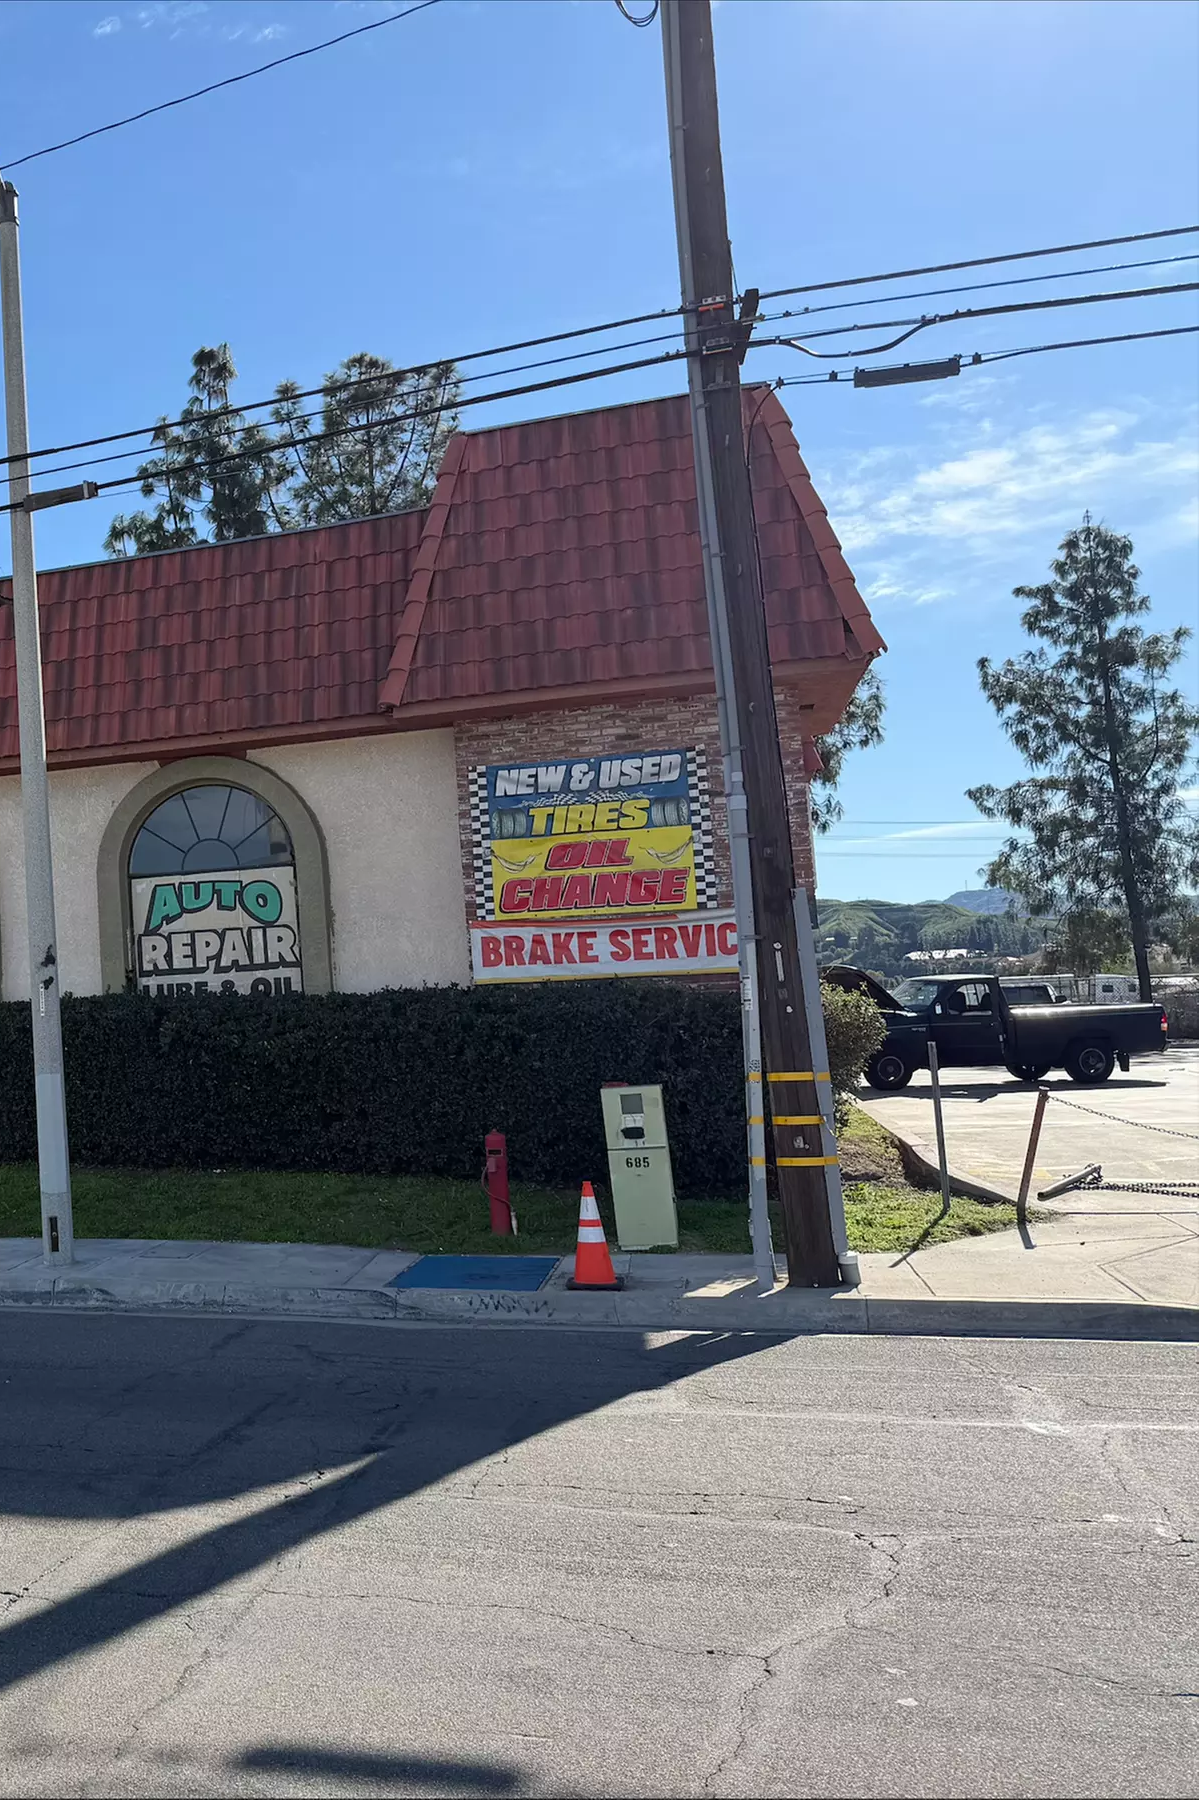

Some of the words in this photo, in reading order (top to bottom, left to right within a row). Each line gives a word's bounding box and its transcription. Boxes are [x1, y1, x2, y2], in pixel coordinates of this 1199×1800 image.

[495, 764, 567, 797] NEW
[570, 762, 596, 791] &
[598, 753, 682, 789] USED
[529, 799, 650, 836] TIRES
[545, 839, 633, 870] OIL
[144, 880, 283, 935] AUTO
[499, 869, 691, 913] CHANGE
[137, 924, 301, 978] REPAIR
[480, 930, 600, 968] BRAKE
[607, 922, 738, 962] SERVIC
[625, 1156, 650, 1168] 685
